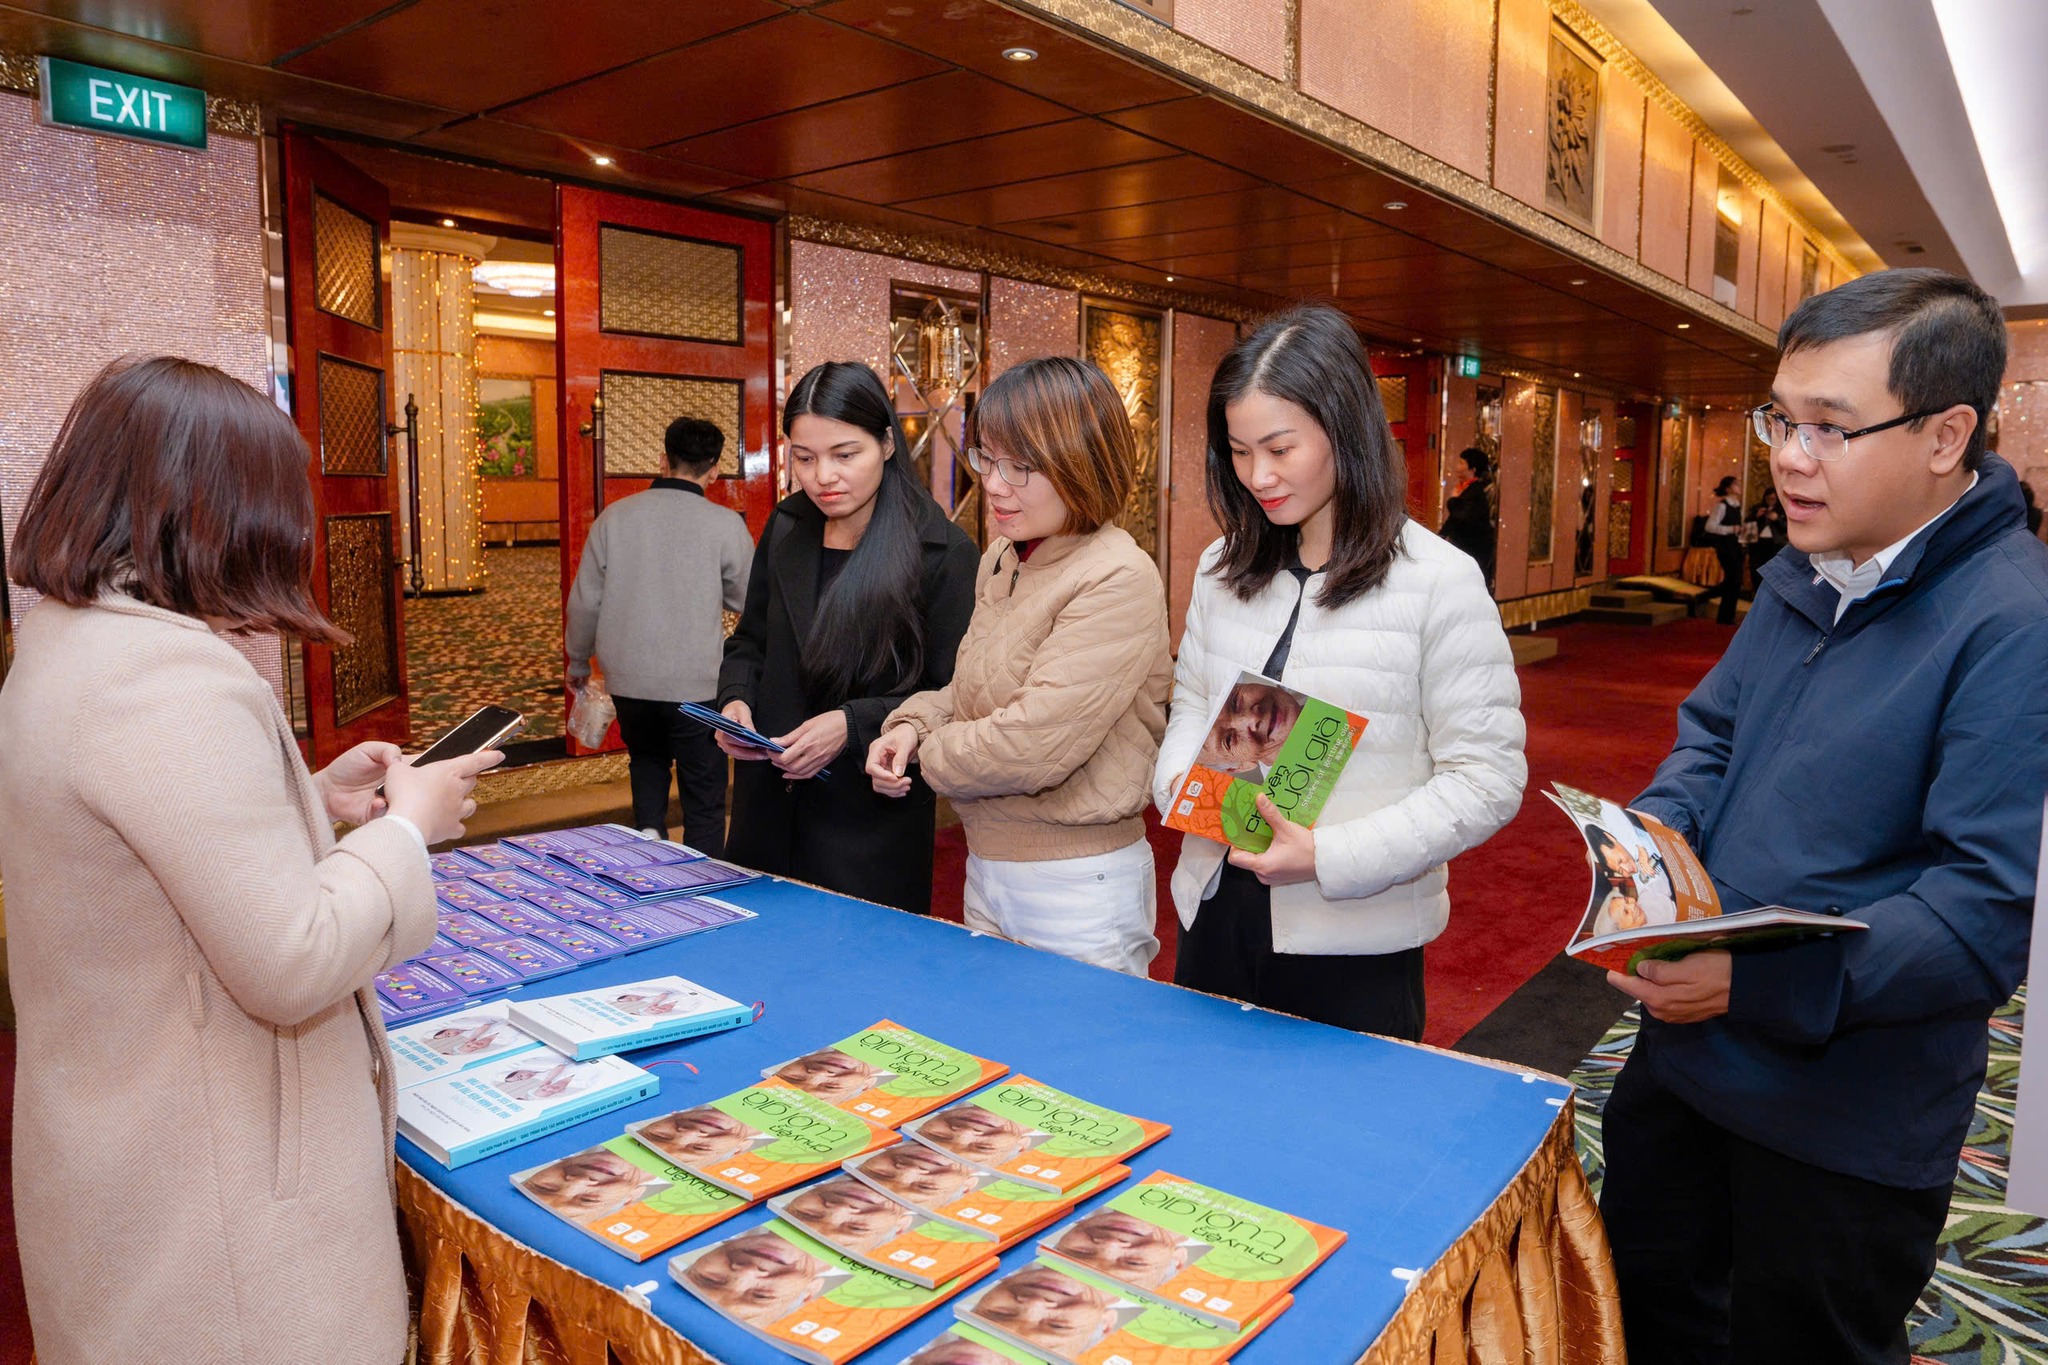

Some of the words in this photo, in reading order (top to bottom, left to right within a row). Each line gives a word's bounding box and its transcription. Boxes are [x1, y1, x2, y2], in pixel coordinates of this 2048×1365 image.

[89, 78, 172, 132] EXIT
[1270, 763, 1315, 824] uổi
[1305, 717, 1341, 761] già
[1246, 765, 1288, 833] Chyện
[1301, 779, 1321, 808] Stories
[1317, 769, 1327, 779] of
[860, 1033, 906, 1055] già
[889, 1062, 950, 1087] Chuyện
[896, 1050, 961, 1077] tuổi
[742, 1091, 792, 1116] già
[998, 1088, 1049, 1112] già
[777, 1112, 848, 1143] tuổi
[1038, 1121, 1113, 1147] Chuyện
[1043, 1108, 1119, 1137] tuổi
[769, 1125, 833, 1153] Chuyện
[1139, 1188, 1200, 1215] già
[1195, 1210, 1286, 1250] tuổi
[1192, 1227, 1284, 1265] Chuyện
